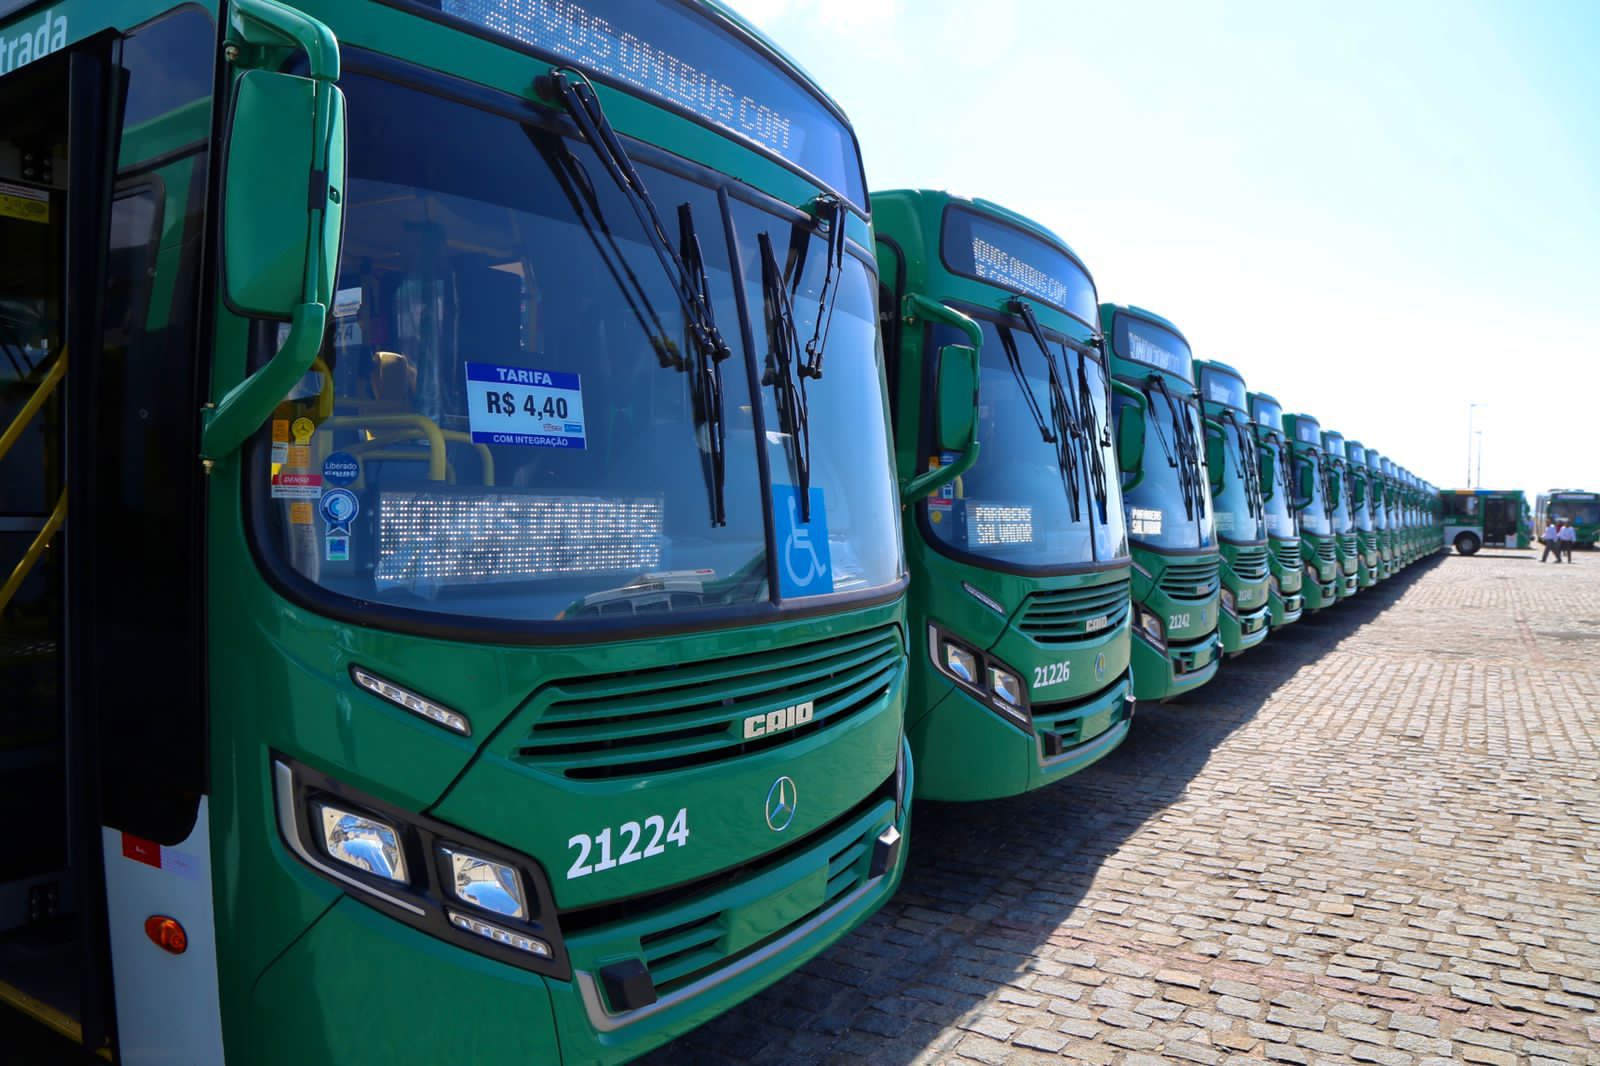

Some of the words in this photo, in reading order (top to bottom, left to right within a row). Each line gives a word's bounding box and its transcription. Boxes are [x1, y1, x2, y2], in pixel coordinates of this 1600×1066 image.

[739, 95, 791, 149] COM
[496, 367, 553, 386] TARIFA
[486, 391, 516, 417] R$
[523, 394, 568, 421] 4,40
[492, 434, 514, 444] COM
[515, 435, 568, 448] INTEGRAÇÃO
[324, 462, 358, 470] Liberado
[1033, 661, 1071, 688] 21226
[743, 700, 814, 739] CAIO
[566, 807, 690, 880] 21224
